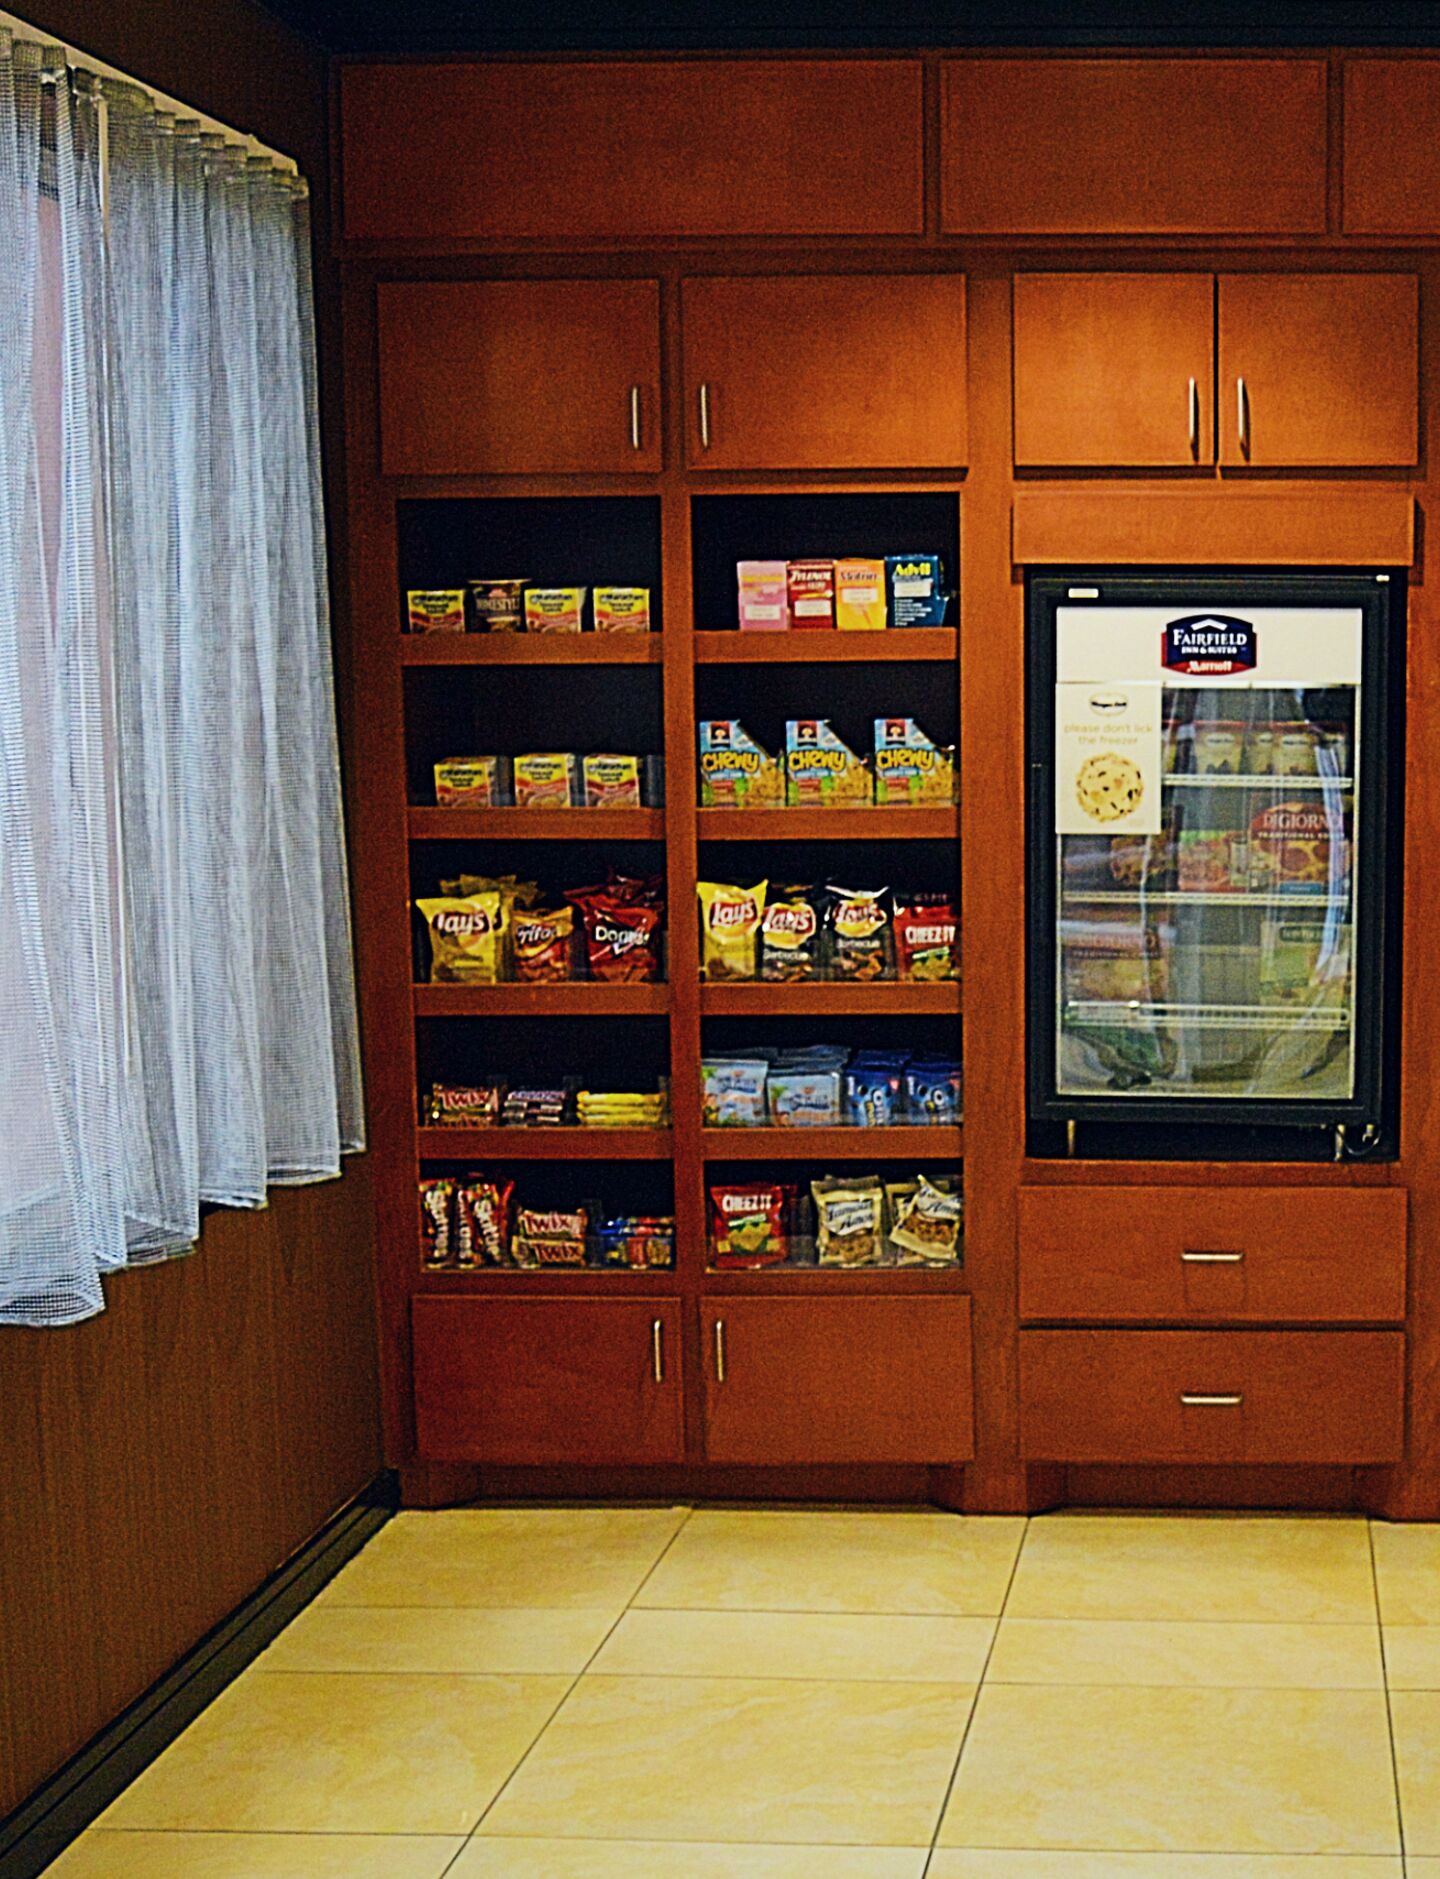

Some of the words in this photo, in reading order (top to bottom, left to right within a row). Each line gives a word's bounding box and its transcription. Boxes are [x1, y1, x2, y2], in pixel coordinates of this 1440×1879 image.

[894, 563, 931, 576] Advil
[1172, 628, 1248, 646] FAIRFIELD
[1263, 813, 1340, 830] DIGIORN
